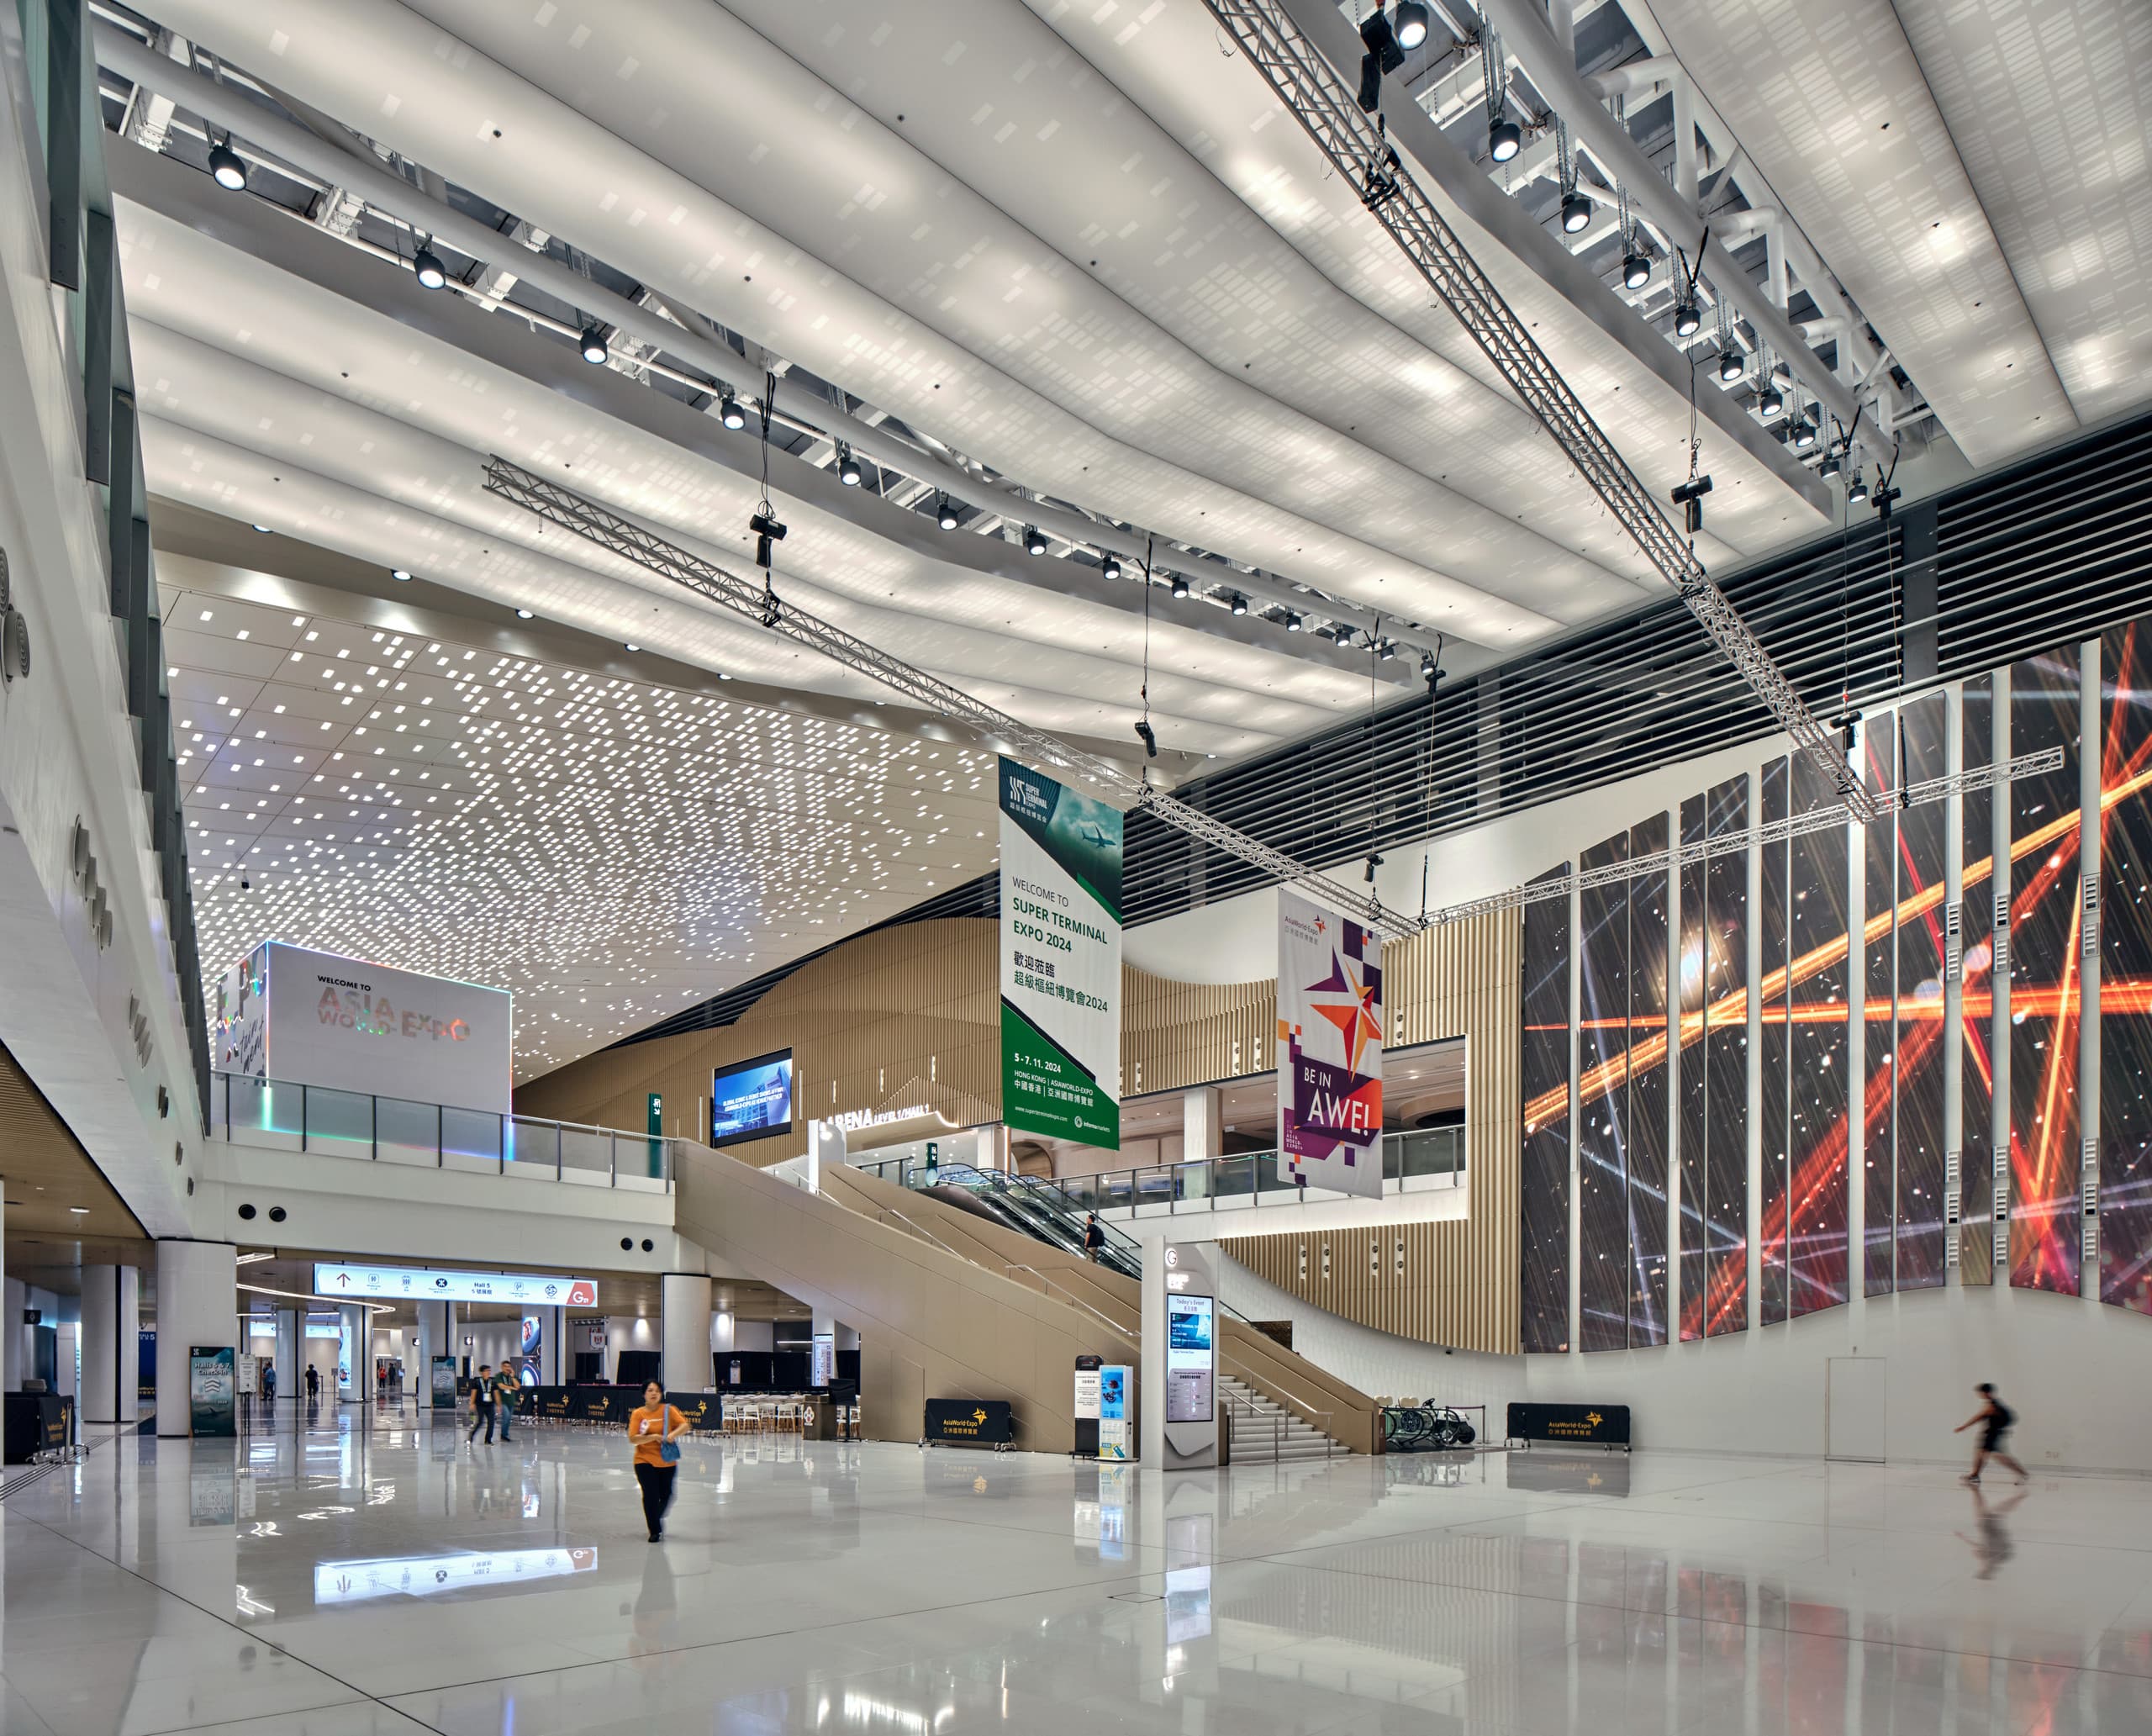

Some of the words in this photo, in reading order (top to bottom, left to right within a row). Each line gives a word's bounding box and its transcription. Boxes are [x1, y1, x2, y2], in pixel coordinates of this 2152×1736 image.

[1026, 792, 1047, 810] TERMINAL
[1012, 876, 1056, 903] WELCOME
[1058, 894, 1069, 908] TO
[1012, 896, 1050, 923] SUPER
[1052, 911, 1108, 945] TERMINAL
[1014, 920, 1043, 942] EXPO
[1046, 932, 1072, 952] 2024
[1014, 951, 1055, 978] 歡迎蒞臨
[317, 974, 358, 989] WELCOME
[361, 984, 372, 992] TO
[1014, 970, 1109, 1013] 超級樞紐博覽會2024
[318, 986, 395, 1022] ASIA
[1014, 1053, 1020, 1062] 5
[1045, 1061, 1062, 1074] 2024
[1014, 1070, 1031, 1080] HONG
[1031, 1074, 1047, 1084] KONG
[1051, 1079, 1094, 1096] ASIAWORLD-EXPO
[1014, 1079, 1042, 1095] 中國香港
[1304, 1066, 1316, 1084] BE
[1319, 1071, 1332, 1089] IN
[1307, 1088, 1369, 1137] AWE!
[1168, 1250, 1177, 1265] G
[572, 1291, 583, 1303] G
[943, 1419, 978, 1427] AsiaWorld-Expo
